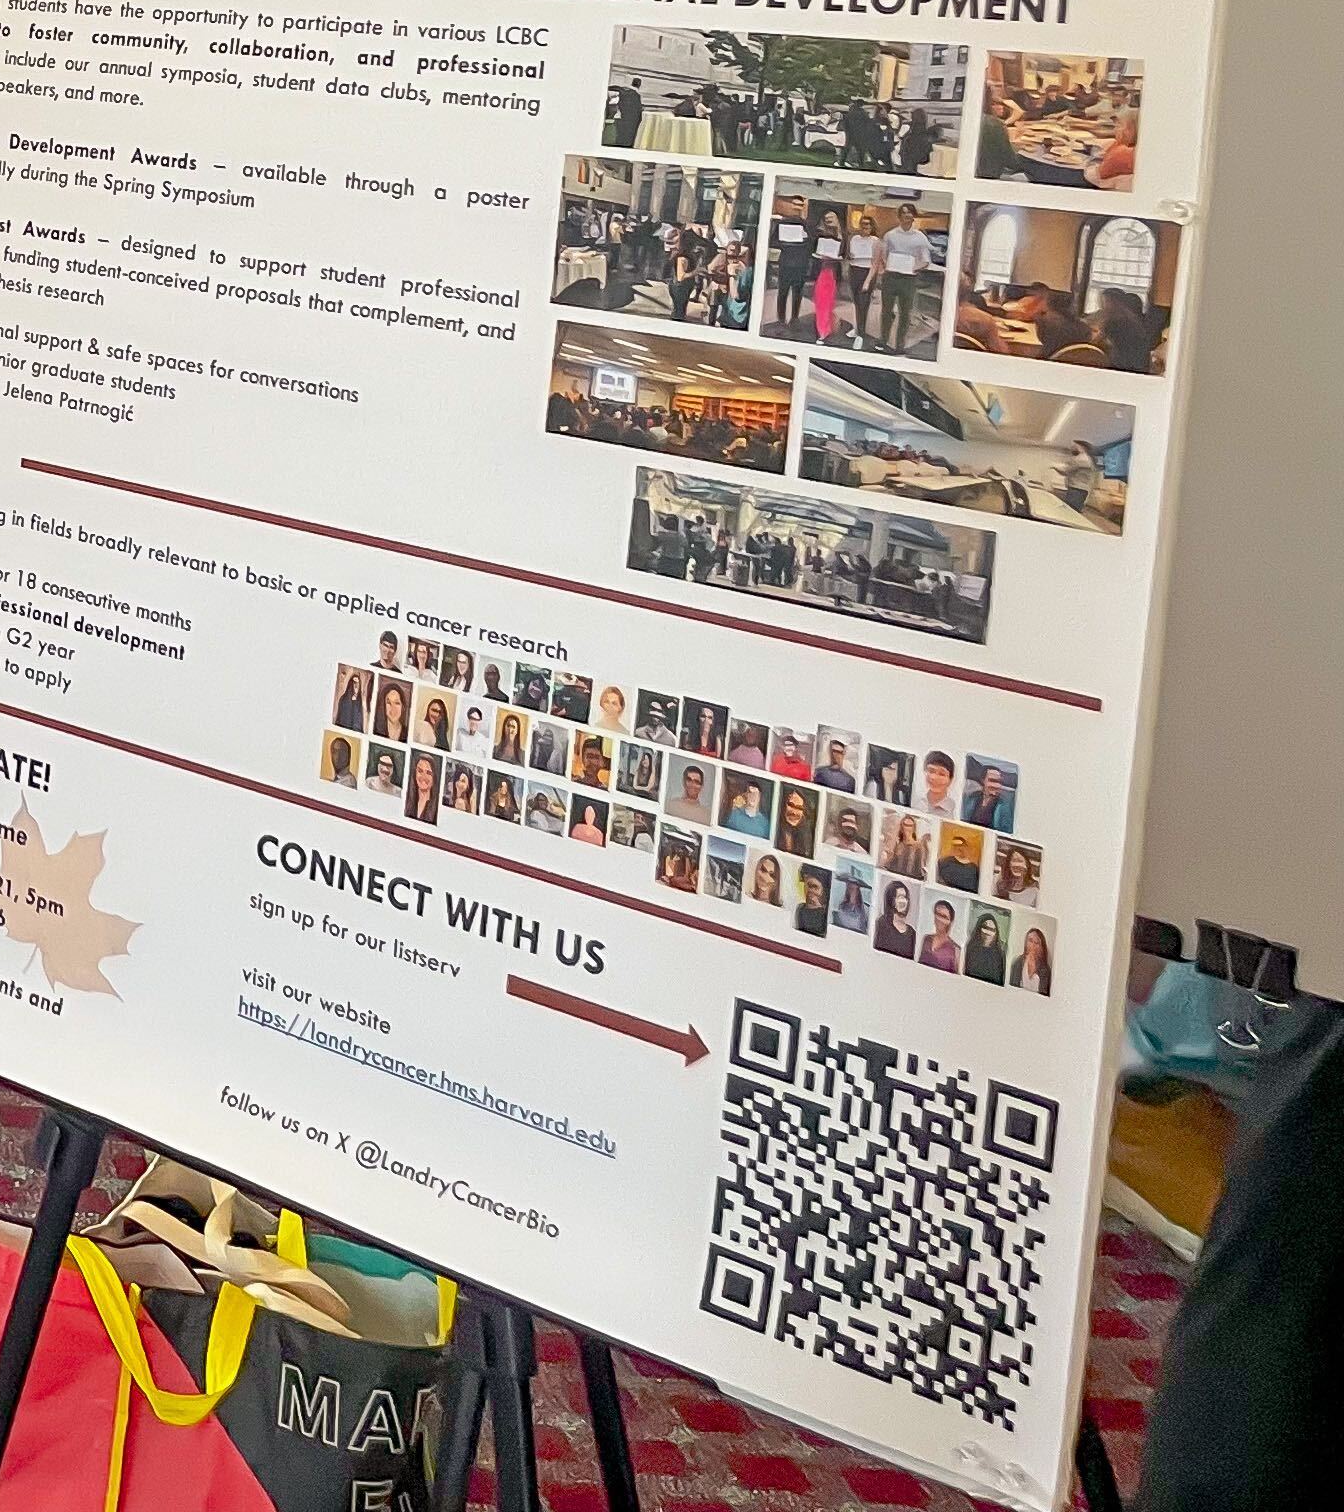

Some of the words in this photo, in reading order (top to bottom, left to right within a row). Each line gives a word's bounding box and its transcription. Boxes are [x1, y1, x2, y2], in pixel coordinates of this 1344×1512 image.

[120, 1, 145, 19] the
[152, 8, 249, 31] opportunity
[257, 13, 274, 28] to
[282, 15, 383, 38] participate
[392, 19, 408, 37] in
[417, 23, 486, 43] various
[496, 25, 550, 47] LCBC
[64, 85, 95, 101] and
[99, 91, 144, 106] more.
[20, 163, 69, 189] during
[74, 169, 98, 188] the
[103, 173, 155, 200] Spring
[160, 180, 255, 208] Symposium
[37, 284, 105, 306] research
[2, 380, 53, 406] Jelena
[11, 509, 25, 528] in
[30, 513, 72, 540] fields
[78, 525, 143, 560] broadly
[148, 546, 217, 575] relevant
[222, 562, 239, 580] to
[245, 565, 293, 594] basic
[297, 584, 318, 600] or
[324, 591, 400, 620] applied
[406, 611, 472, 637] cancer
[478, 627, 568, 662] research
[73, 615, 185, 661] development
[25, 887, 64, 917] 5pm
[256, 834, 433, 918] CONNECT
[445, 891, 540, 955] WITH
[555, 928, 606, 975] US
[249, 892, 285, 920] sign
[291, 909, 315, 932] up
[322, 914, 349, 940] for
[355, 932, 387, 953] our
[393, 938, 461, 978] listserv
[242, 967, 277, 992] visit
[282, 984, 313, 1005] our
[319, 997, 391, 1035] website
[237, 994, 616, 1160] https://landrycancer.hms.harvard.edu
[220, 1085, 276, 1122] follow
[281, 1116, 301, 1134] us
[305, 1126, 329, 1146] on
[334, 1131, 351, 1154] X
[355, 1140, 560, 1238] @LandryCancerBio
